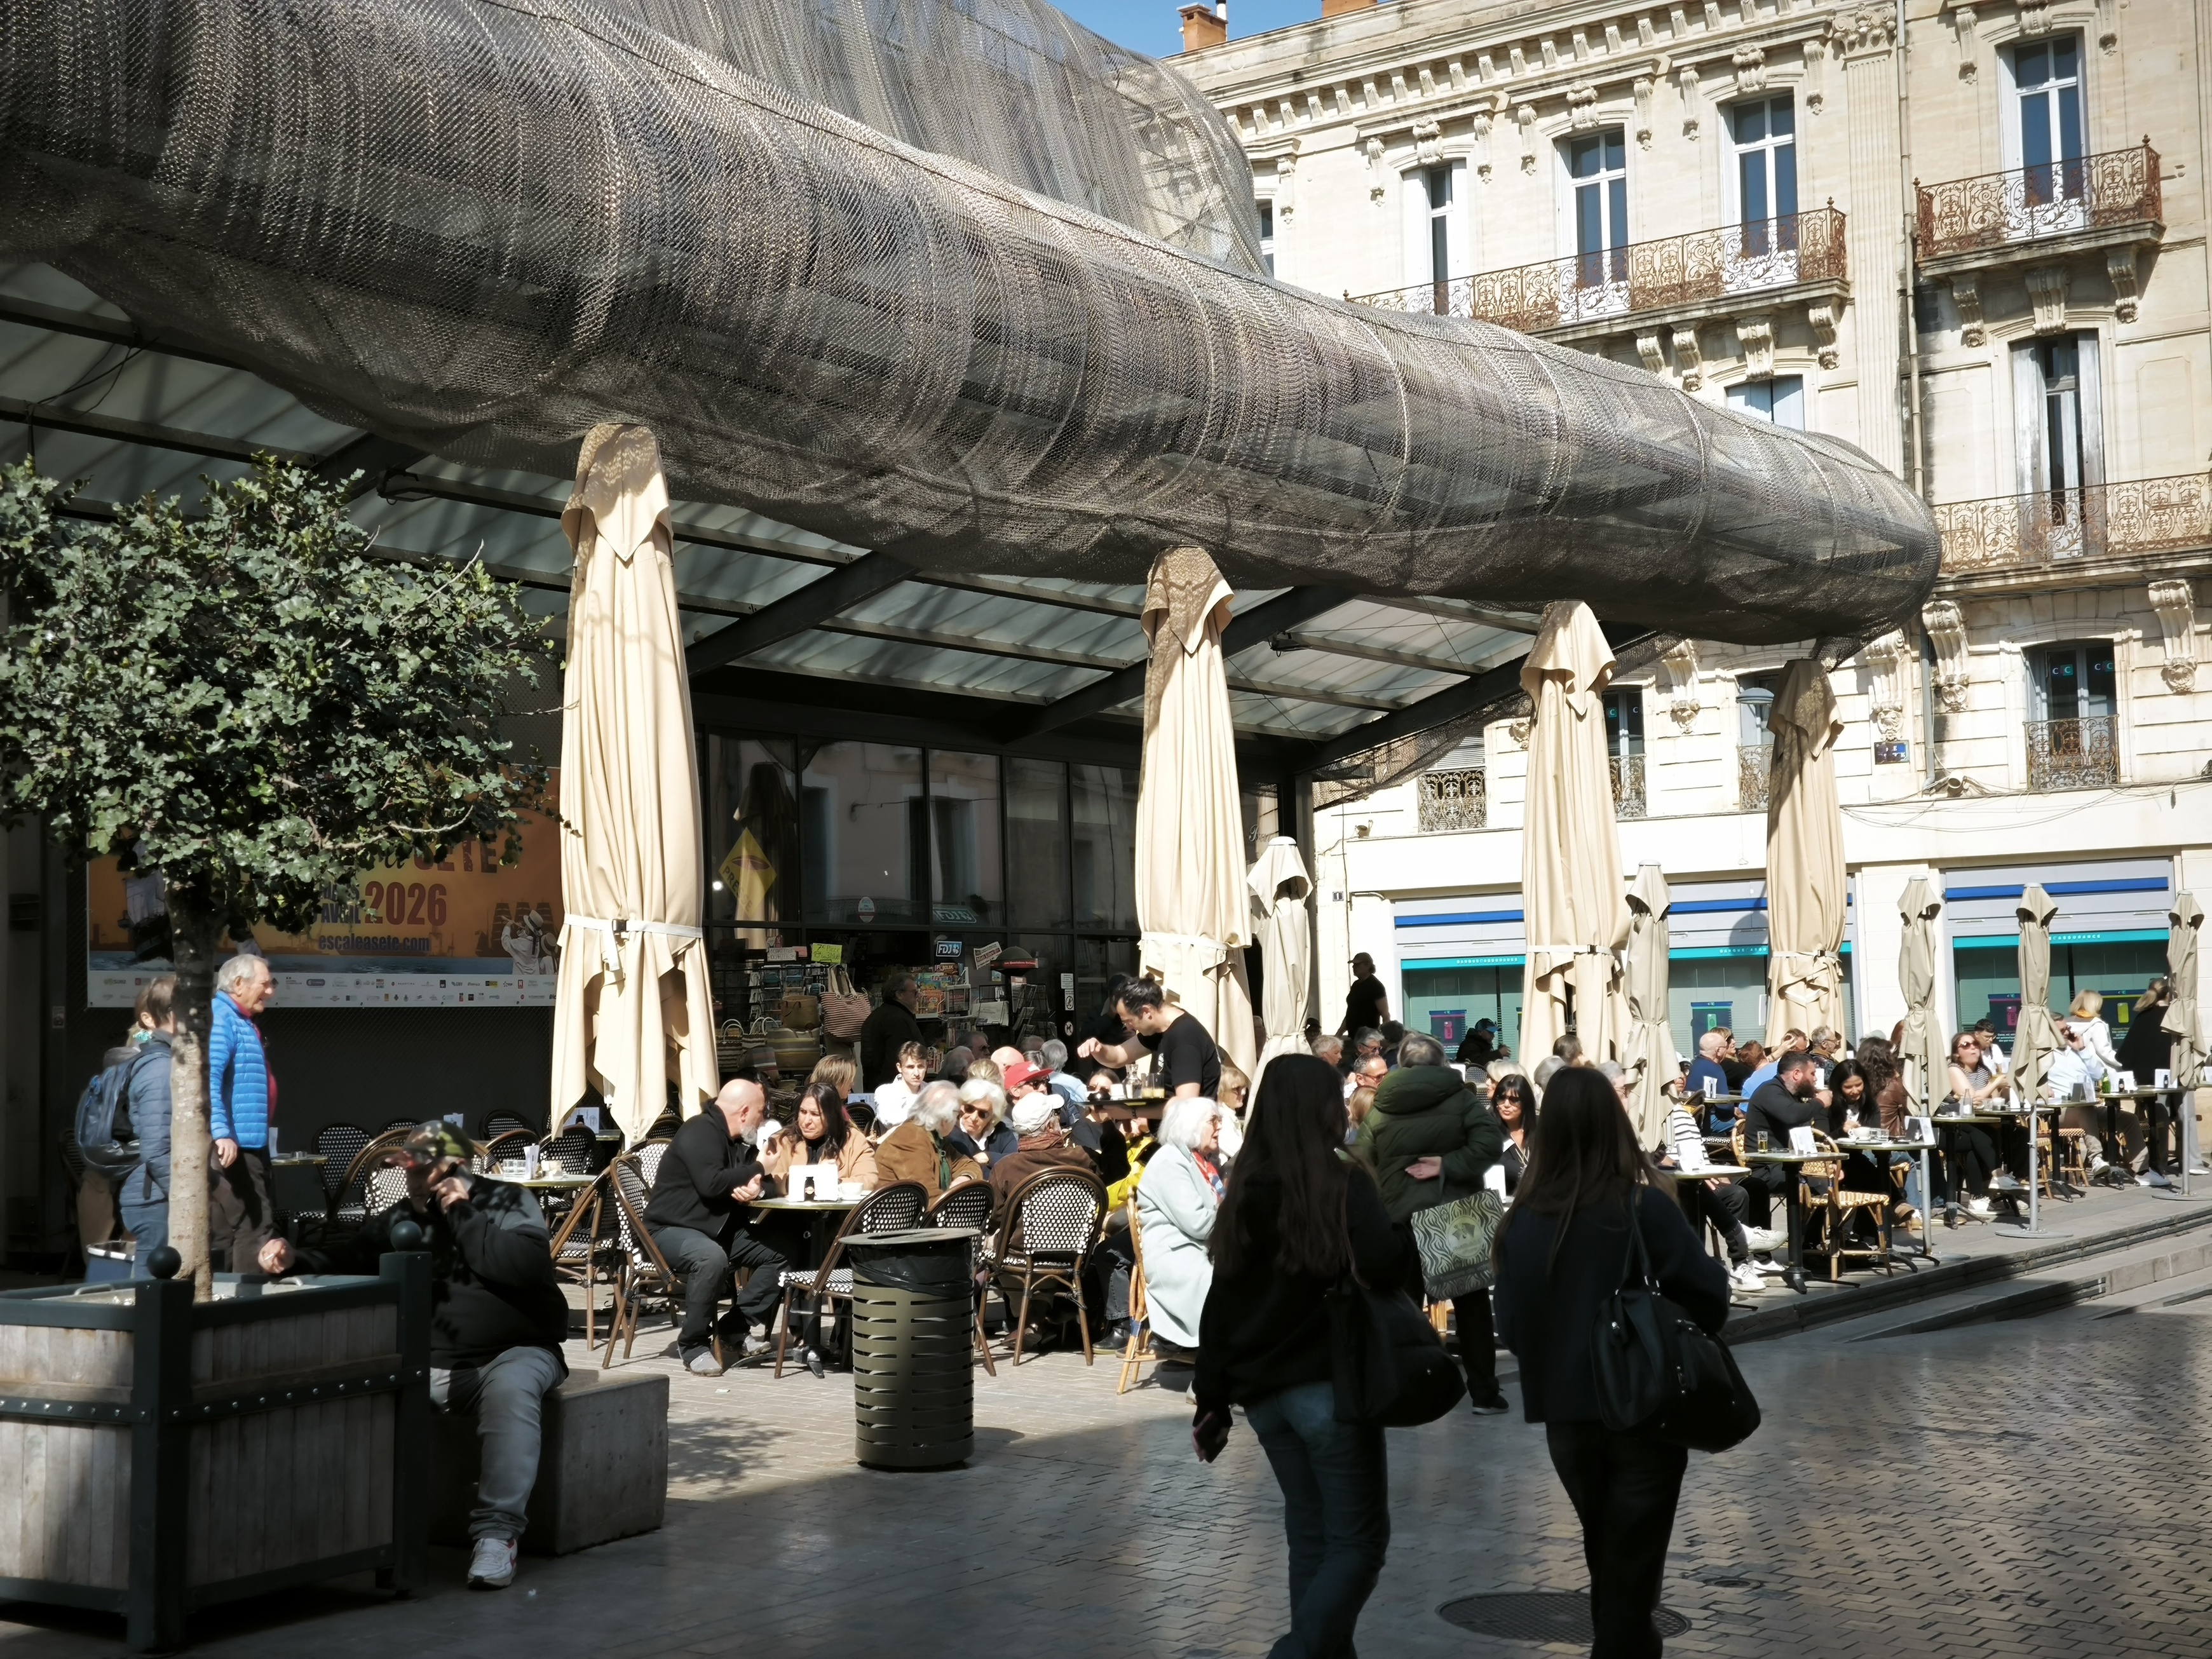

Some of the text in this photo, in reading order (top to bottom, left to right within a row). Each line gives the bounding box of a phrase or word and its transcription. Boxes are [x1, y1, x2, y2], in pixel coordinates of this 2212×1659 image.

[364, 881, 447, 926] 2026
[318, 934, 430, 952] escaleasete.com
[938, 944, 952, 954] FDJ
